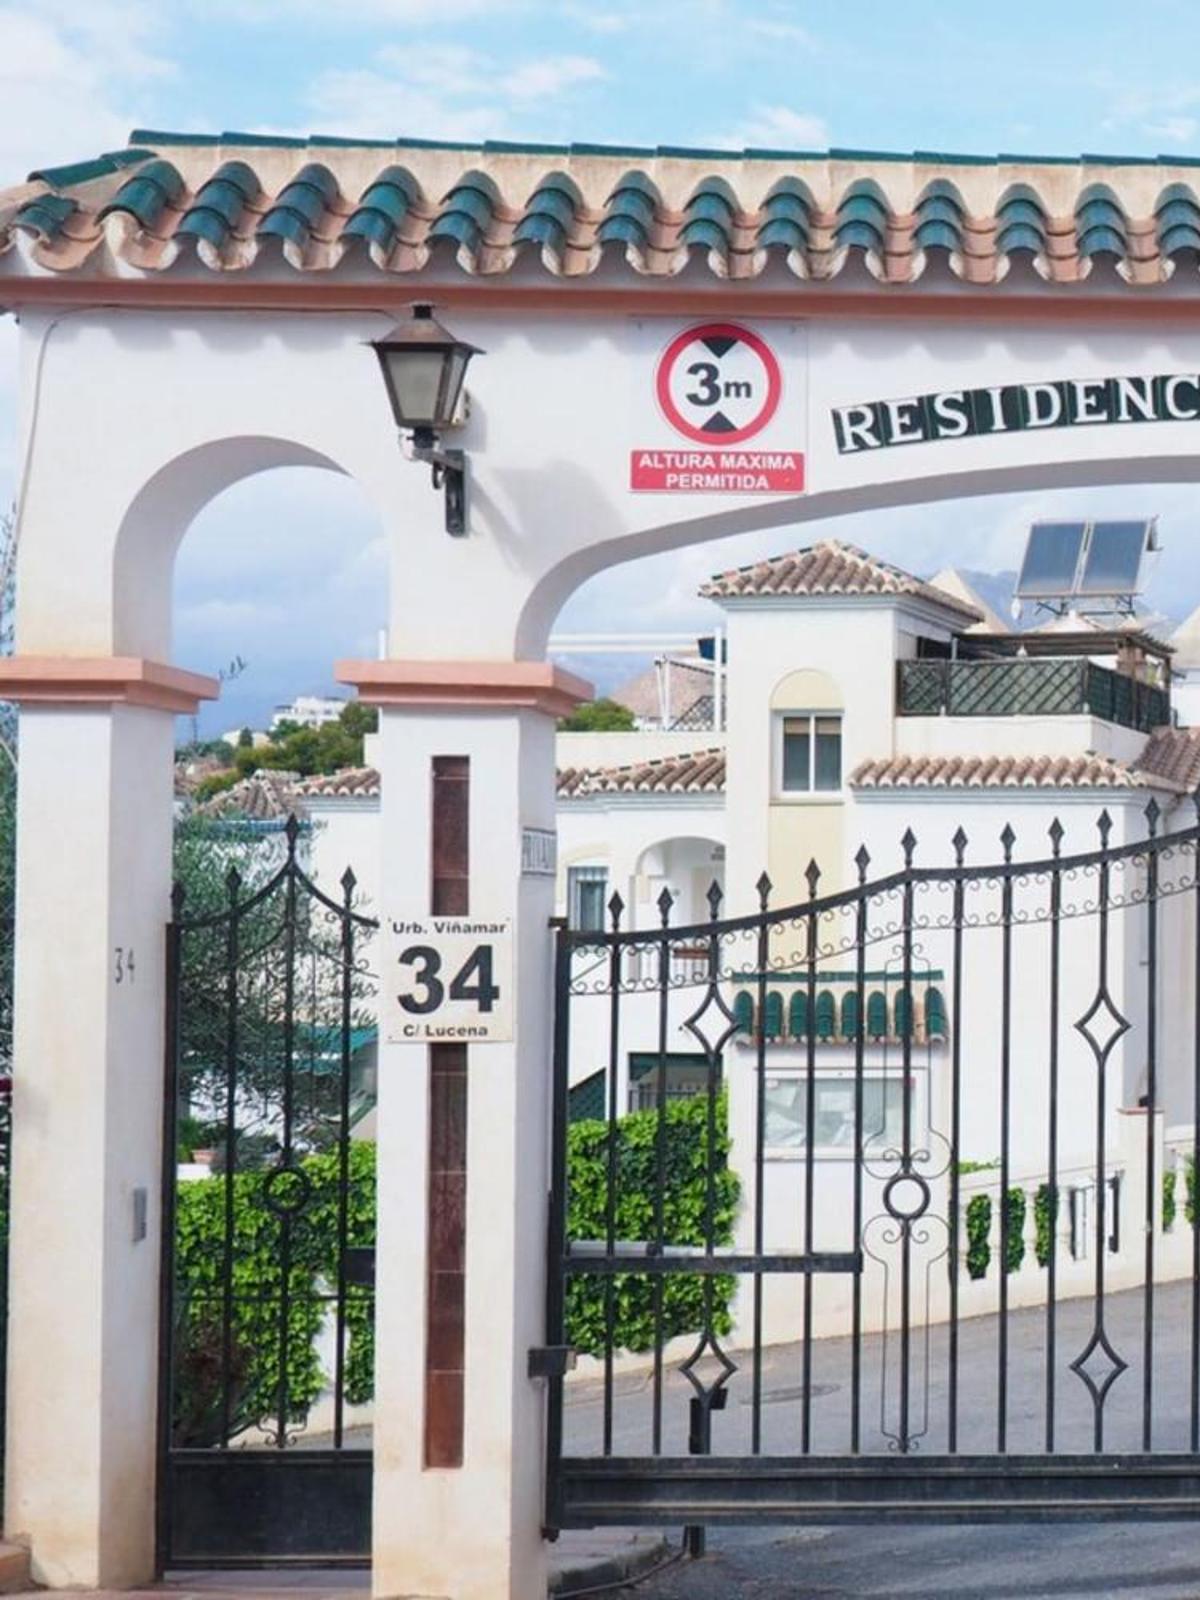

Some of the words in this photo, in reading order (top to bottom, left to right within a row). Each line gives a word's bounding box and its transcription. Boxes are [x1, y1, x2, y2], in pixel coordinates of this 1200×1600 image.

[685, 362, 751, 407] 3m
[639, 452, 716, 470] ALTURA
[720, 453, 797, 470] MAXIMA
[666, 473, 770, 489] PERMITIDA
[392, 922, 428, 935] Urb.
[434, 921, 506, 935] Viñamar
[114, 946, 136, 985] 34
[397, 944, 500, 1015] 34
[425, 1023, 488, 1038] Lucena
